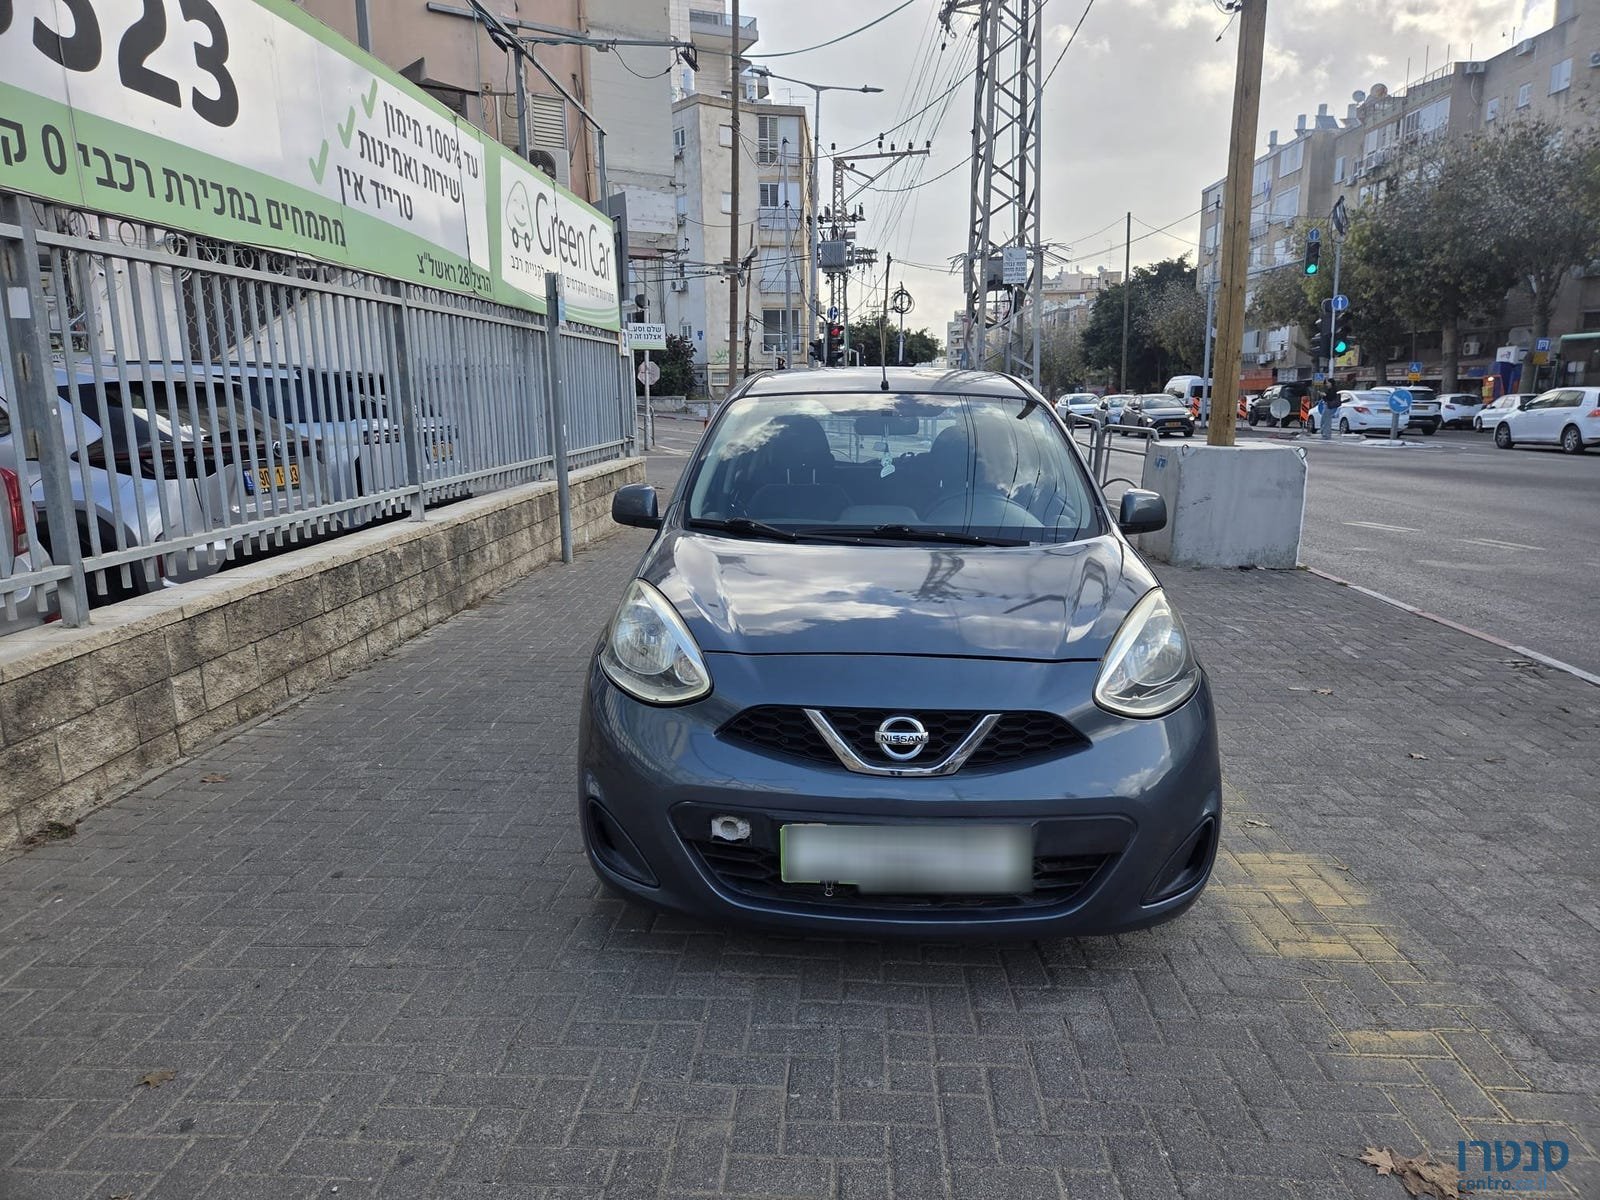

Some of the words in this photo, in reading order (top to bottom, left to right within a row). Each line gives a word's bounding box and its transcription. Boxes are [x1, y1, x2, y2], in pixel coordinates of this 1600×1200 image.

[383, 101, 423, 148] מימון
[41, 124, 67, 175] 0
[358, 130, 419, 185] ואמינות
[426, 125, 461, 169] 100%
[463, 151, 479, 179] עד
[77, 142, 155, 199] רכבי
[337, 165, 367, 206] אין
[422, 163, 460, 203] שירות
[162, 167, 261, 225] במכירת
[370, 179, 413, 221] טרייד
[266, 198, 346, 247] מתמחים
[536, 192, 587, 271] Green
[589, 223, 610, 281] Car
[457, 264, 470, 286] 28
[470, 267, 492, 293] הרצל
[510, 255, 523, 272] רכב
[646, 325, 662, 333] שלם
